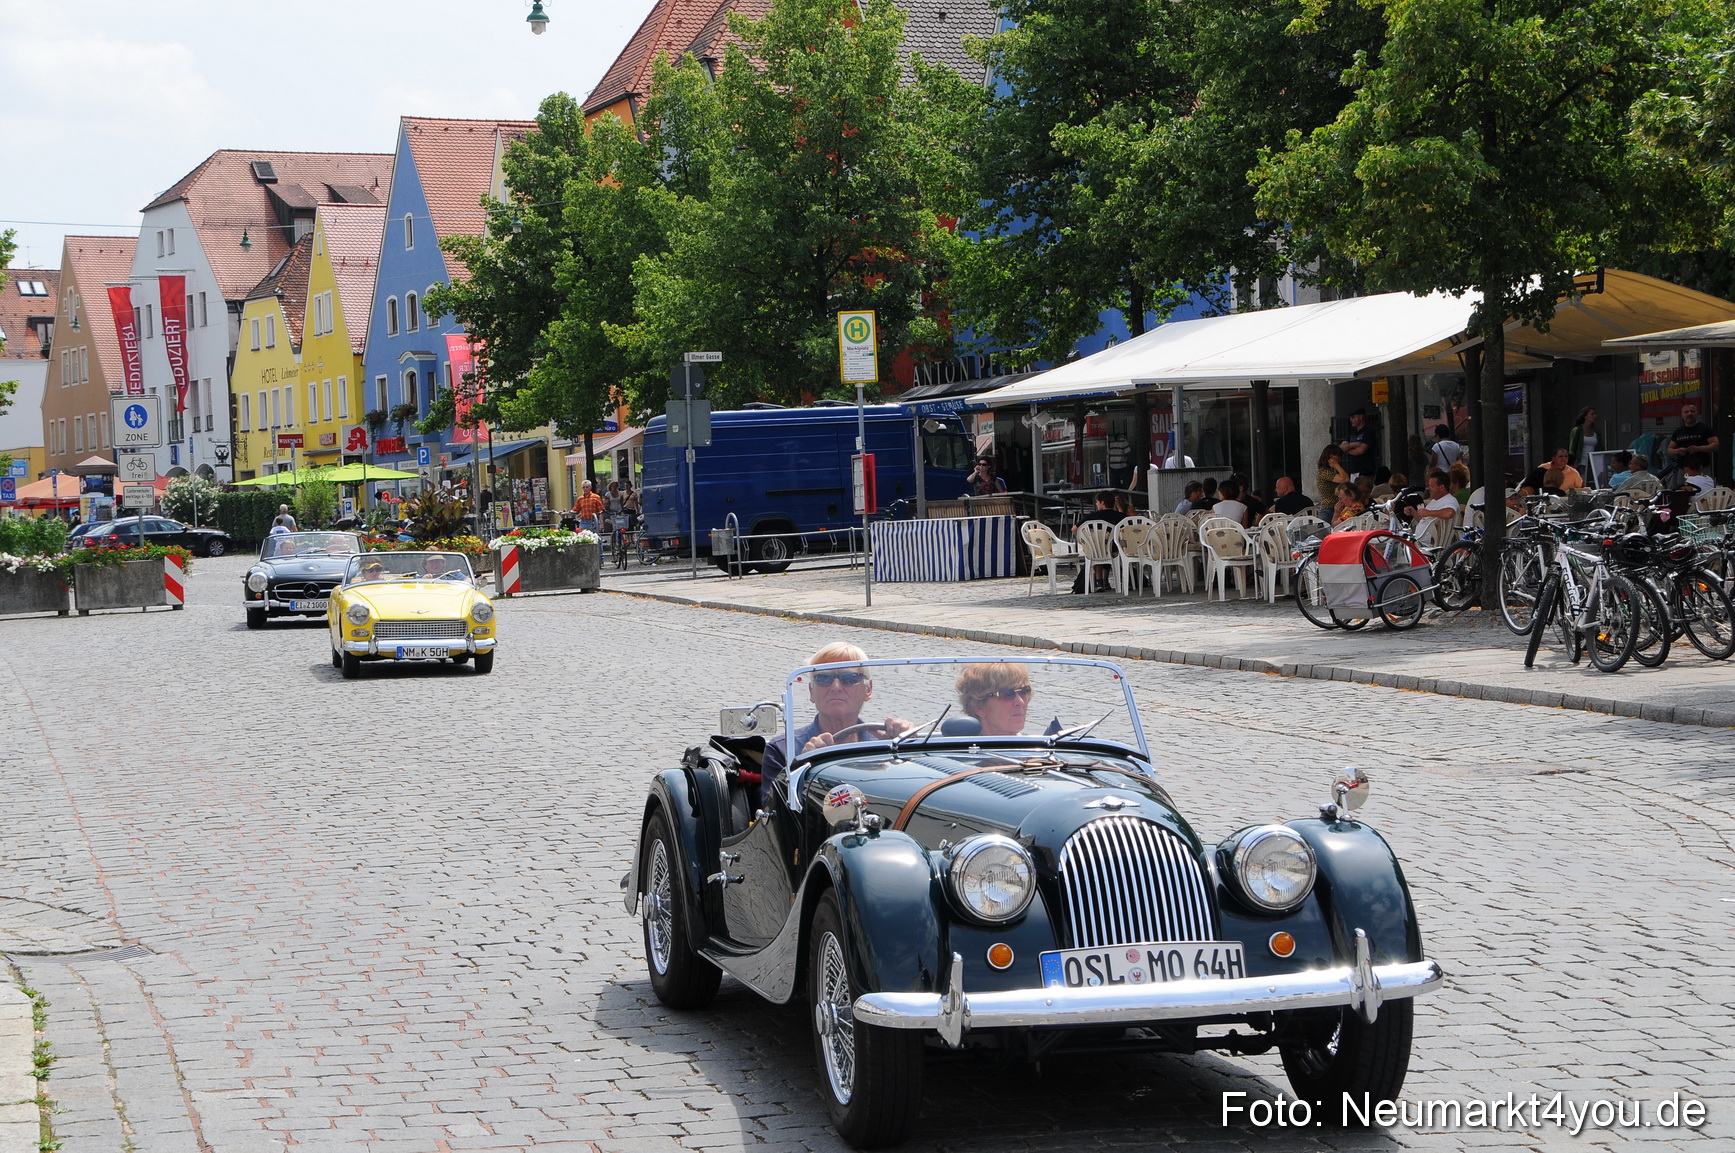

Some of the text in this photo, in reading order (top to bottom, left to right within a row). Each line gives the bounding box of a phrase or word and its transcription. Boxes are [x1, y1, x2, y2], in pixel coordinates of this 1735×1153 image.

[850, 322, 864, 337] H
[165, 317, 186, 389] EDUZIERT
[261, 366, 299, 385] HOTEL Lehmeier
[913, 356, 969, 388] ANTON
[1640, 366, 1702, 384] Wir schlißen
[1641, 389, 1660, 404] TOTAL
[921, 399, 964, 413] OBST GEMÜSE
[125, 433, 149, 442] ZONE
[264, 447, 286, 458] Restrant
[420, 449, 428, 464] P
[402, 647, 449, 657] NM K 50H
[1064, 953, 1126, 988] OSL
[1147, 949, 1186, 983] MO
[1193, 949, 1244, 980] 64H
